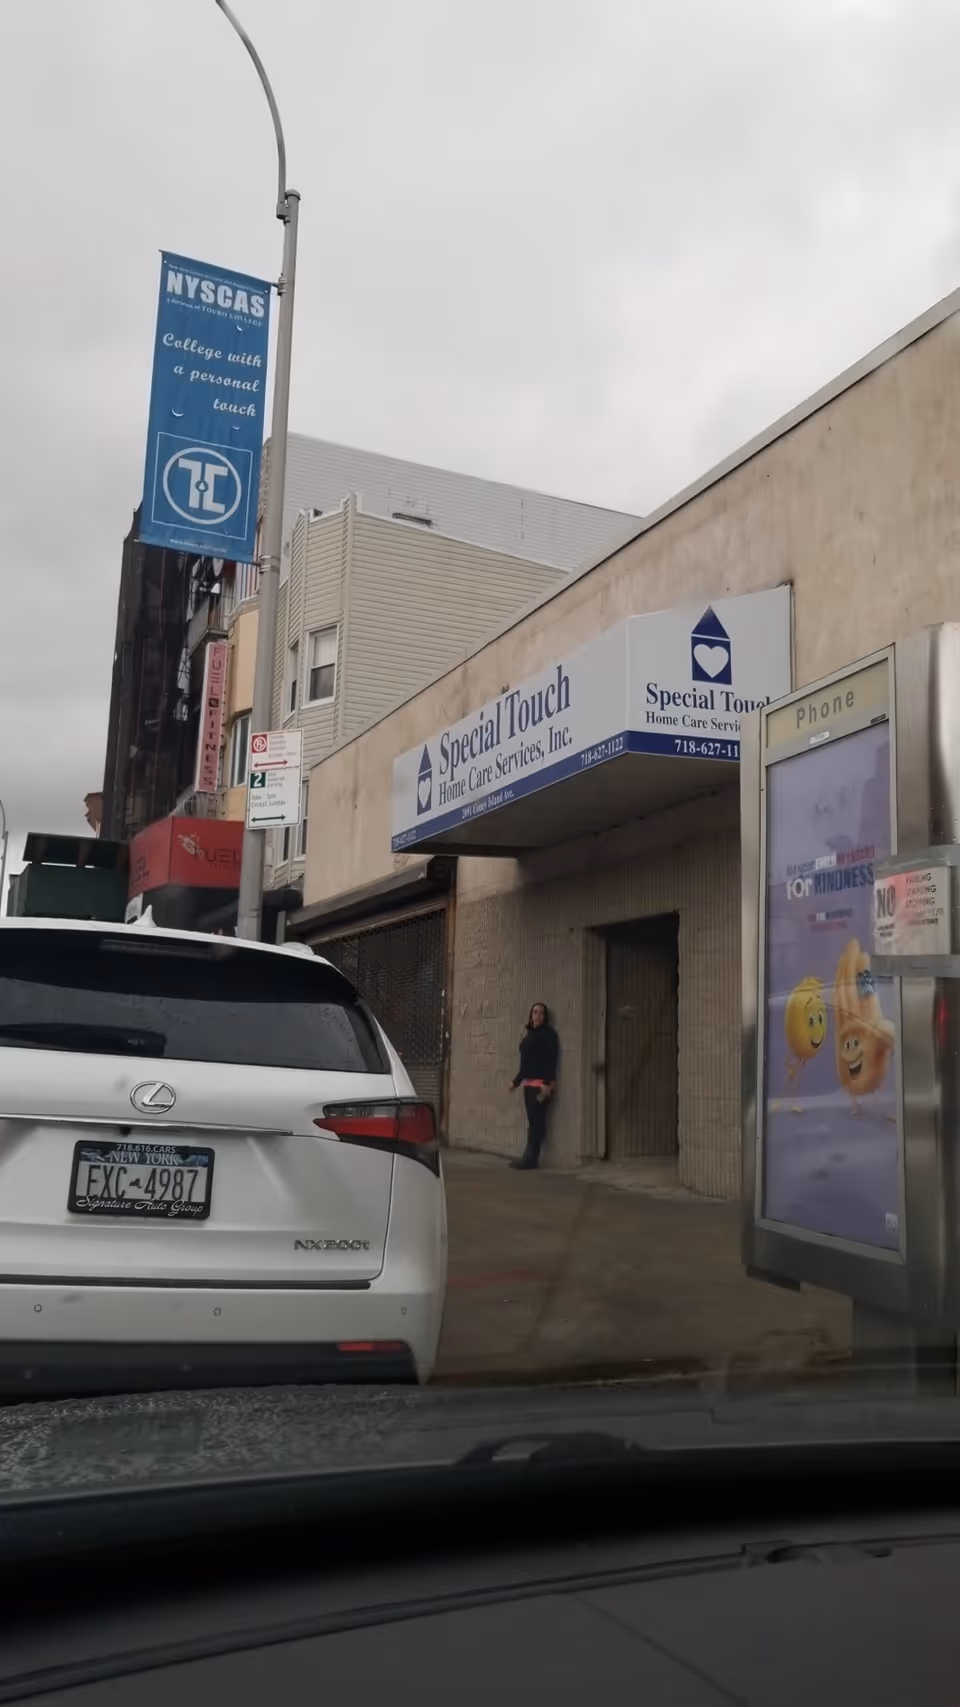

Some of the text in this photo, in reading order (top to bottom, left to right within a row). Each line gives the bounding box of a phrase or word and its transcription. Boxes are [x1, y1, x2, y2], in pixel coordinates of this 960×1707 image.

[167, 270, 264, 317] NYSCAS
[163, 333, 262, 368] College with
[173, 364, 260, 392] a personal
[213, 399, 257, 417] touch
[646, 682, 715, 711] Special
[796, 691, 855, 729] Phone
[439, 664, 571, 781] Special Touch
[645, 711, 741, 732] Home Care Servi
[580, 737, 624, 767] 718-627-1122
[675, 739, 740, 757] 718-627-11
[253, 772, 263, 788] 2
[438, 725, 573, 807] Home Care Services, Inc.
[877, 885, 896, 918] NO
[110, 1151, 179, 1165] NEW YORK
[116, 1143, 176, 1153] 718.616.CARS
[144, 1168, 199, 1202] 4987
[76, 1194, 203, 1216] Signature Auto Group
[294, 1239, 370, 1250] NX200t
